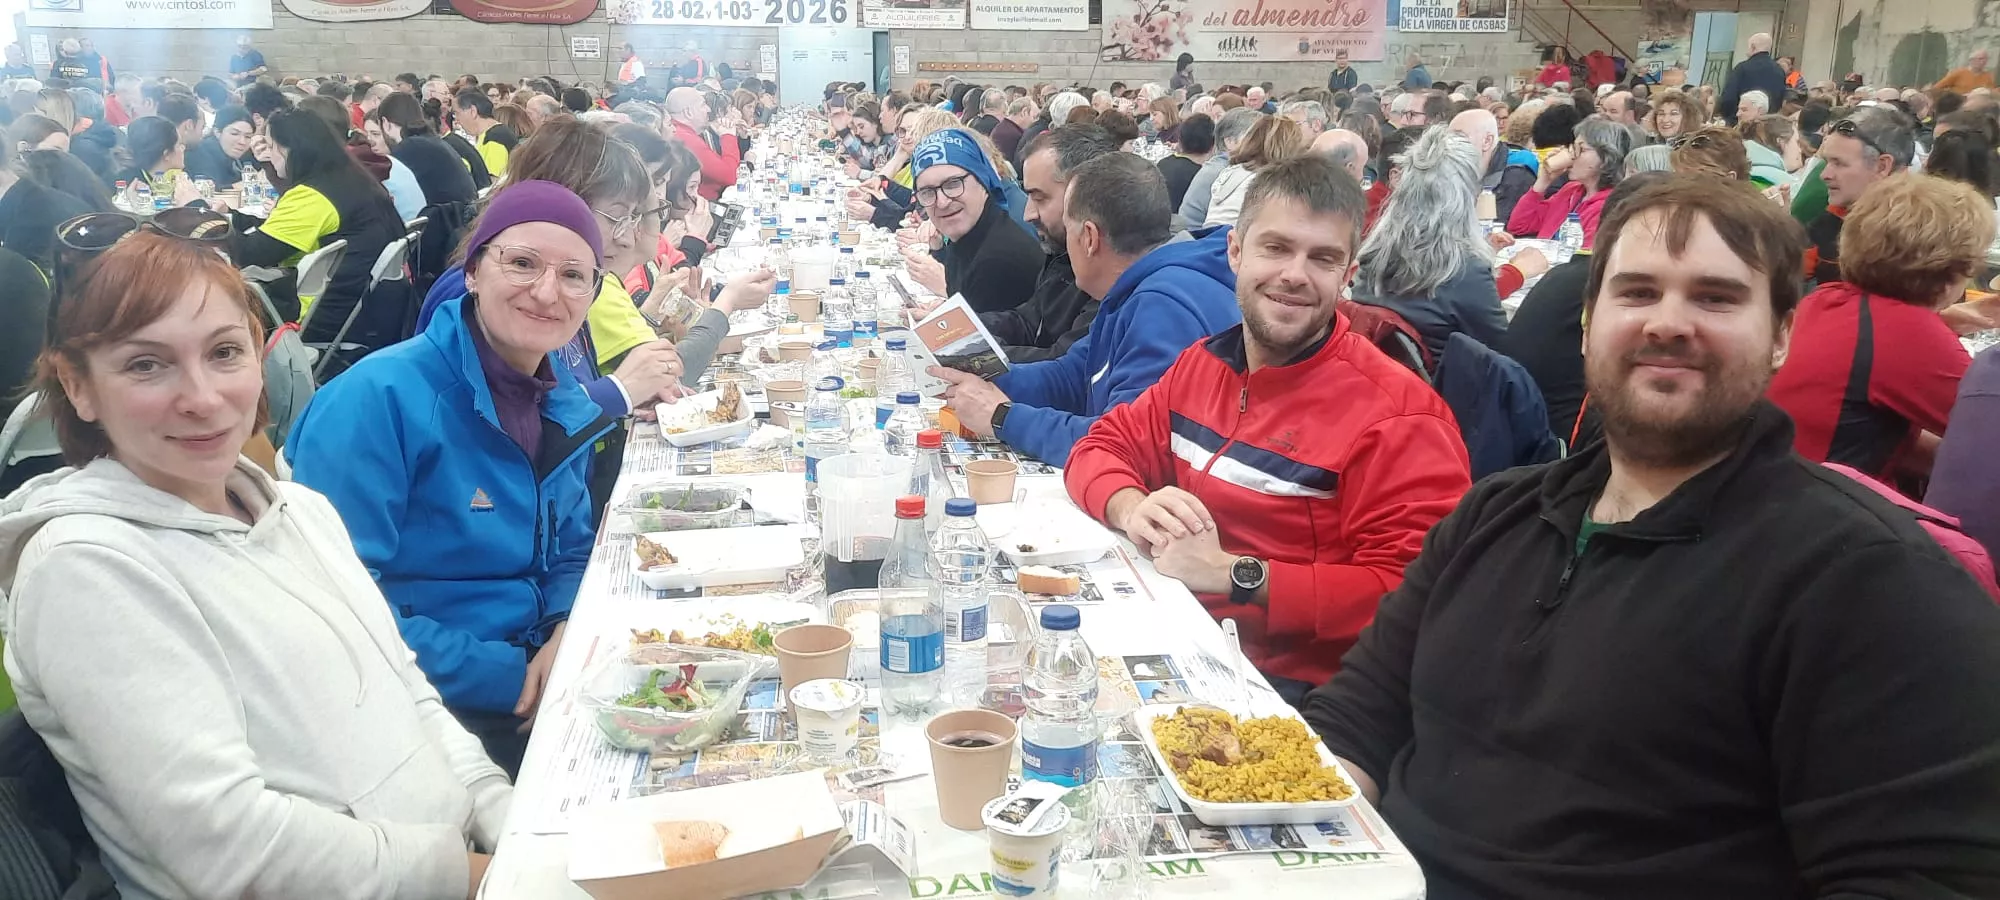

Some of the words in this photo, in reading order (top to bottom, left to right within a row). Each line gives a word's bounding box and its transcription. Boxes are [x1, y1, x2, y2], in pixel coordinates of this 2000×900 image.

[976, 5, 1011, 13] ALQUILER
[1025, 6, 1084, 14] APARTAMENTOS
[1203, 11, 1227, 26] del
[1232, 0, 1370, 28] almendro
[1402, 7, 1453, 18] PROPIEDAD
[1401, 18, 1412, 29] DE
[1414, 19, 1424, 30] LA
[1427, 19, 1457, 30] VIRGEN
[1460, 20, 1471, 30] DE
[1472, 20, 1506, 30] CASBAS
